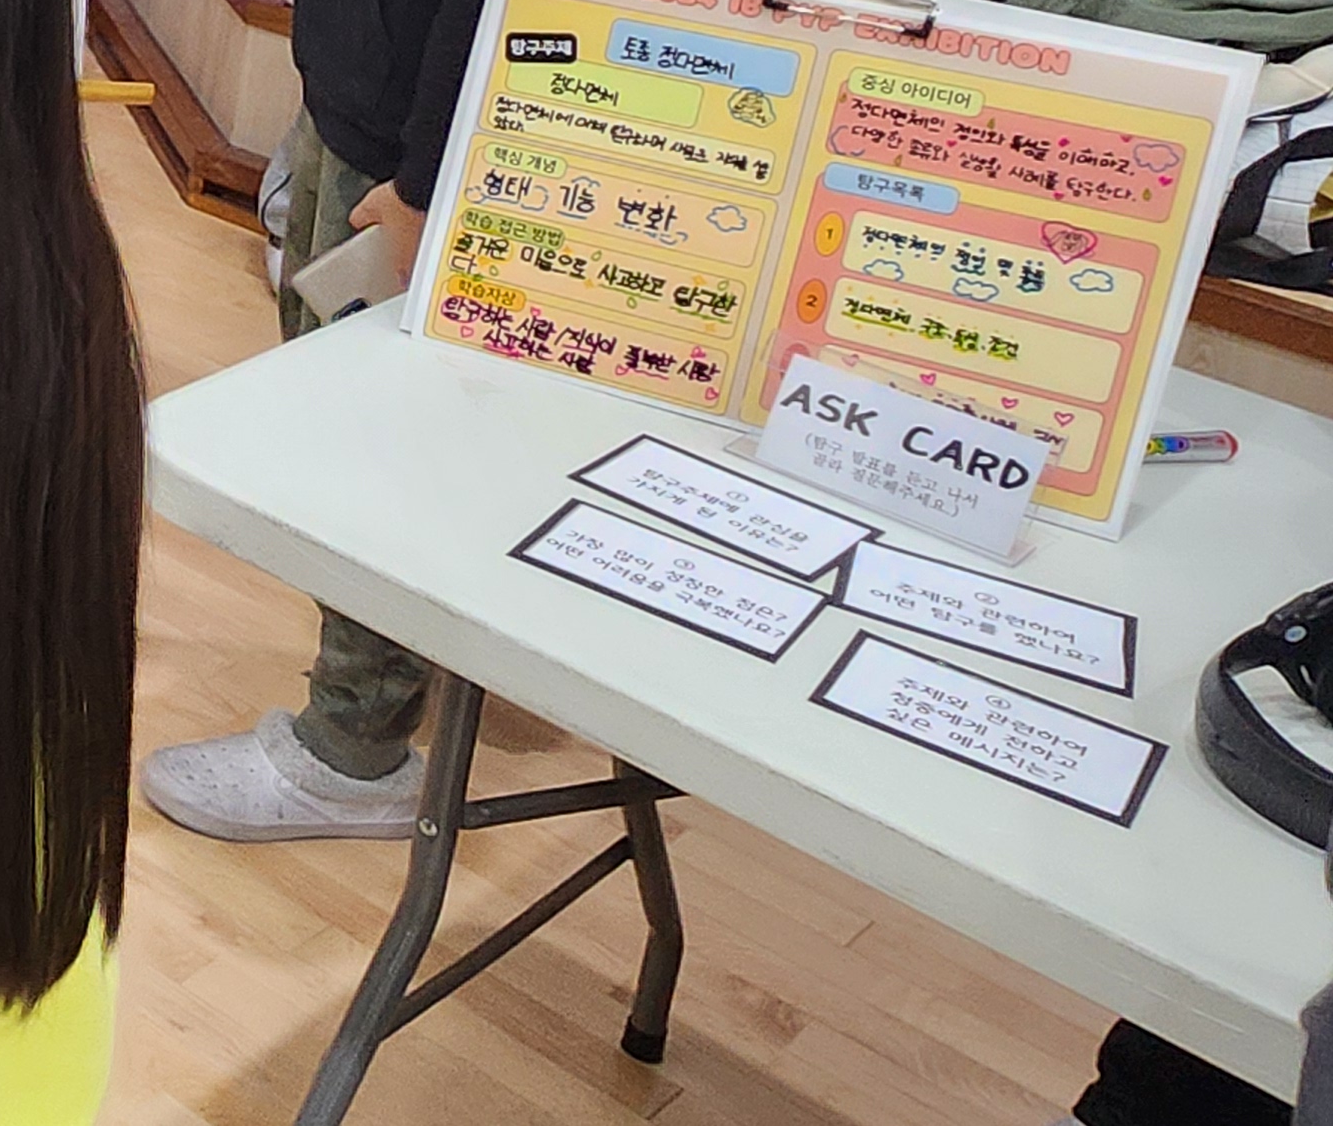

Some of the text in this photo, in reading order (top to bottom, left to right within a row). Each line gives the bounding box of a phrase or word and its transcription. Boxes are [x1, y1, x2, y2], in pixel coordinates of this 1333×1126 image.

[549, 72, 620, 107] 정다면체
[657, 45, 736, 80] 정다면체
[860, 74, 973, 110] 중심 아이디어
[493, 146, 558, 175] 핵심 개념
[856, 173, 926, 203] 탐구목록
[483, 169, 678, 232] 형태 기능 변화
[498, 218, 529, 239] 접근
[531, 225, 564, 248] 방법
[825, 228, 835, 240] 1
[805, 295, 818, 308] 2
[779, 383, 880, 438] ASK
[901, 425, 1030, 491] CARD
[812, 453, 844, 474] 골라
[803, 431, 980, 510] (탐구 발표를 듣고 나서
[626, 475, 801, 556] 가지게 된 이유는?
[639, 467, 811, 545] 탐구주제에 관심을
[544, 537, 788, 641] 어떤 어려움을 극복했나요?
[564, 529, 789, 624] 가장 많이 성장한 점은?
[868, 587, 1101, 666] 어떤 탐구를 했나요?
[895, 581, 1077, 645] 주제와 관련하여
[884, 706, 1067, 785] 싶은 메시지는?
[888, 690, 1079, 770] 청중에게 전하고
[896, 676, 1089, 759] 주제와 관련하여
